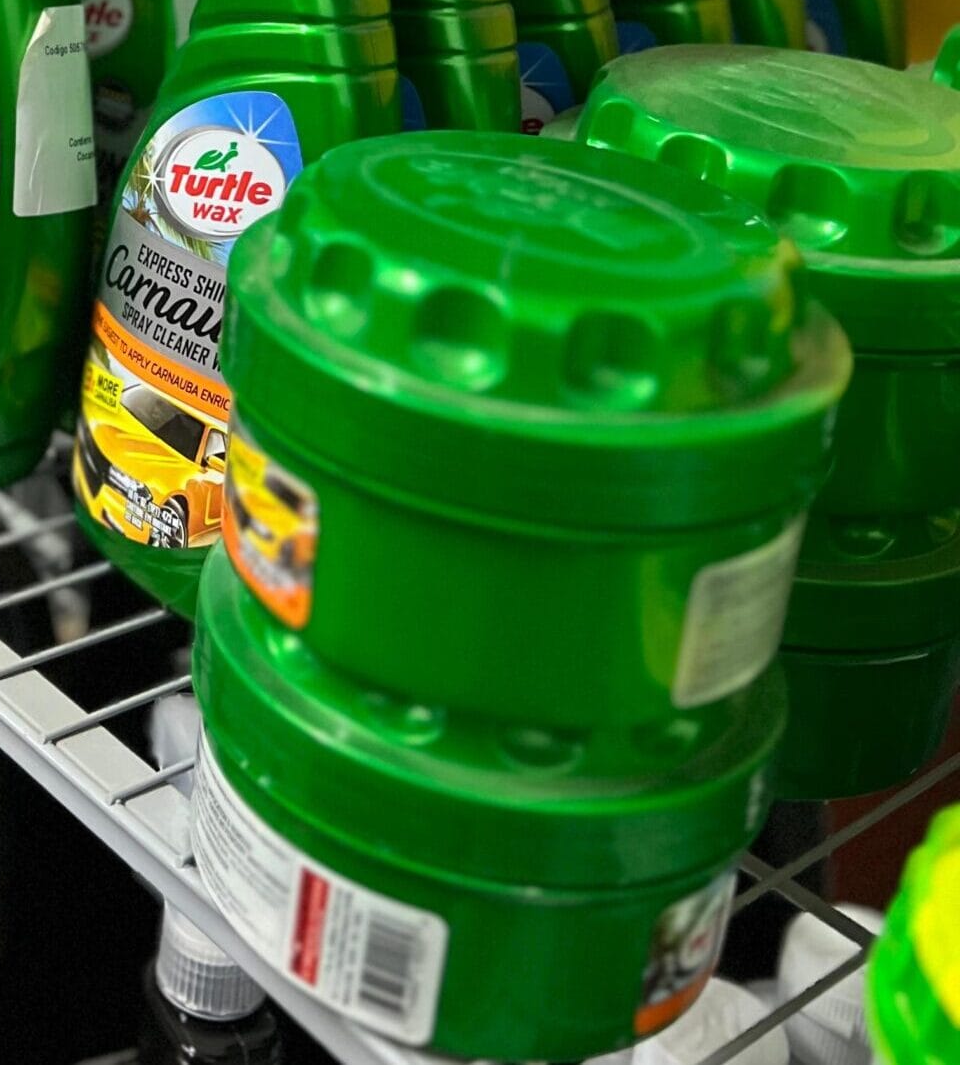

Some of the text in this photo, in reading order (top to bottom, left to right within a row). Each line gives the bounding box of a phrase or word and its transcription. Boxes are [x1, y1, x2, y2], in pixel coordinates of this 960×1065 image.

[169, 164, 272, 205] Turtle
[192, 202, 243, 224] wax
[137, 243, 193, 289] EXPRESS
[105, 244, 222, 344] Carnau
[122, 301, 152, 336] SPRAY
[152, 323, 210, 366] CLEANER
[98, 375, 119, 397] MORE
[128, 349, 151, 369] APPLY
[151, 362, 198, 397] CARNAUBA
[200, 388, 230, 412] ENRIC
